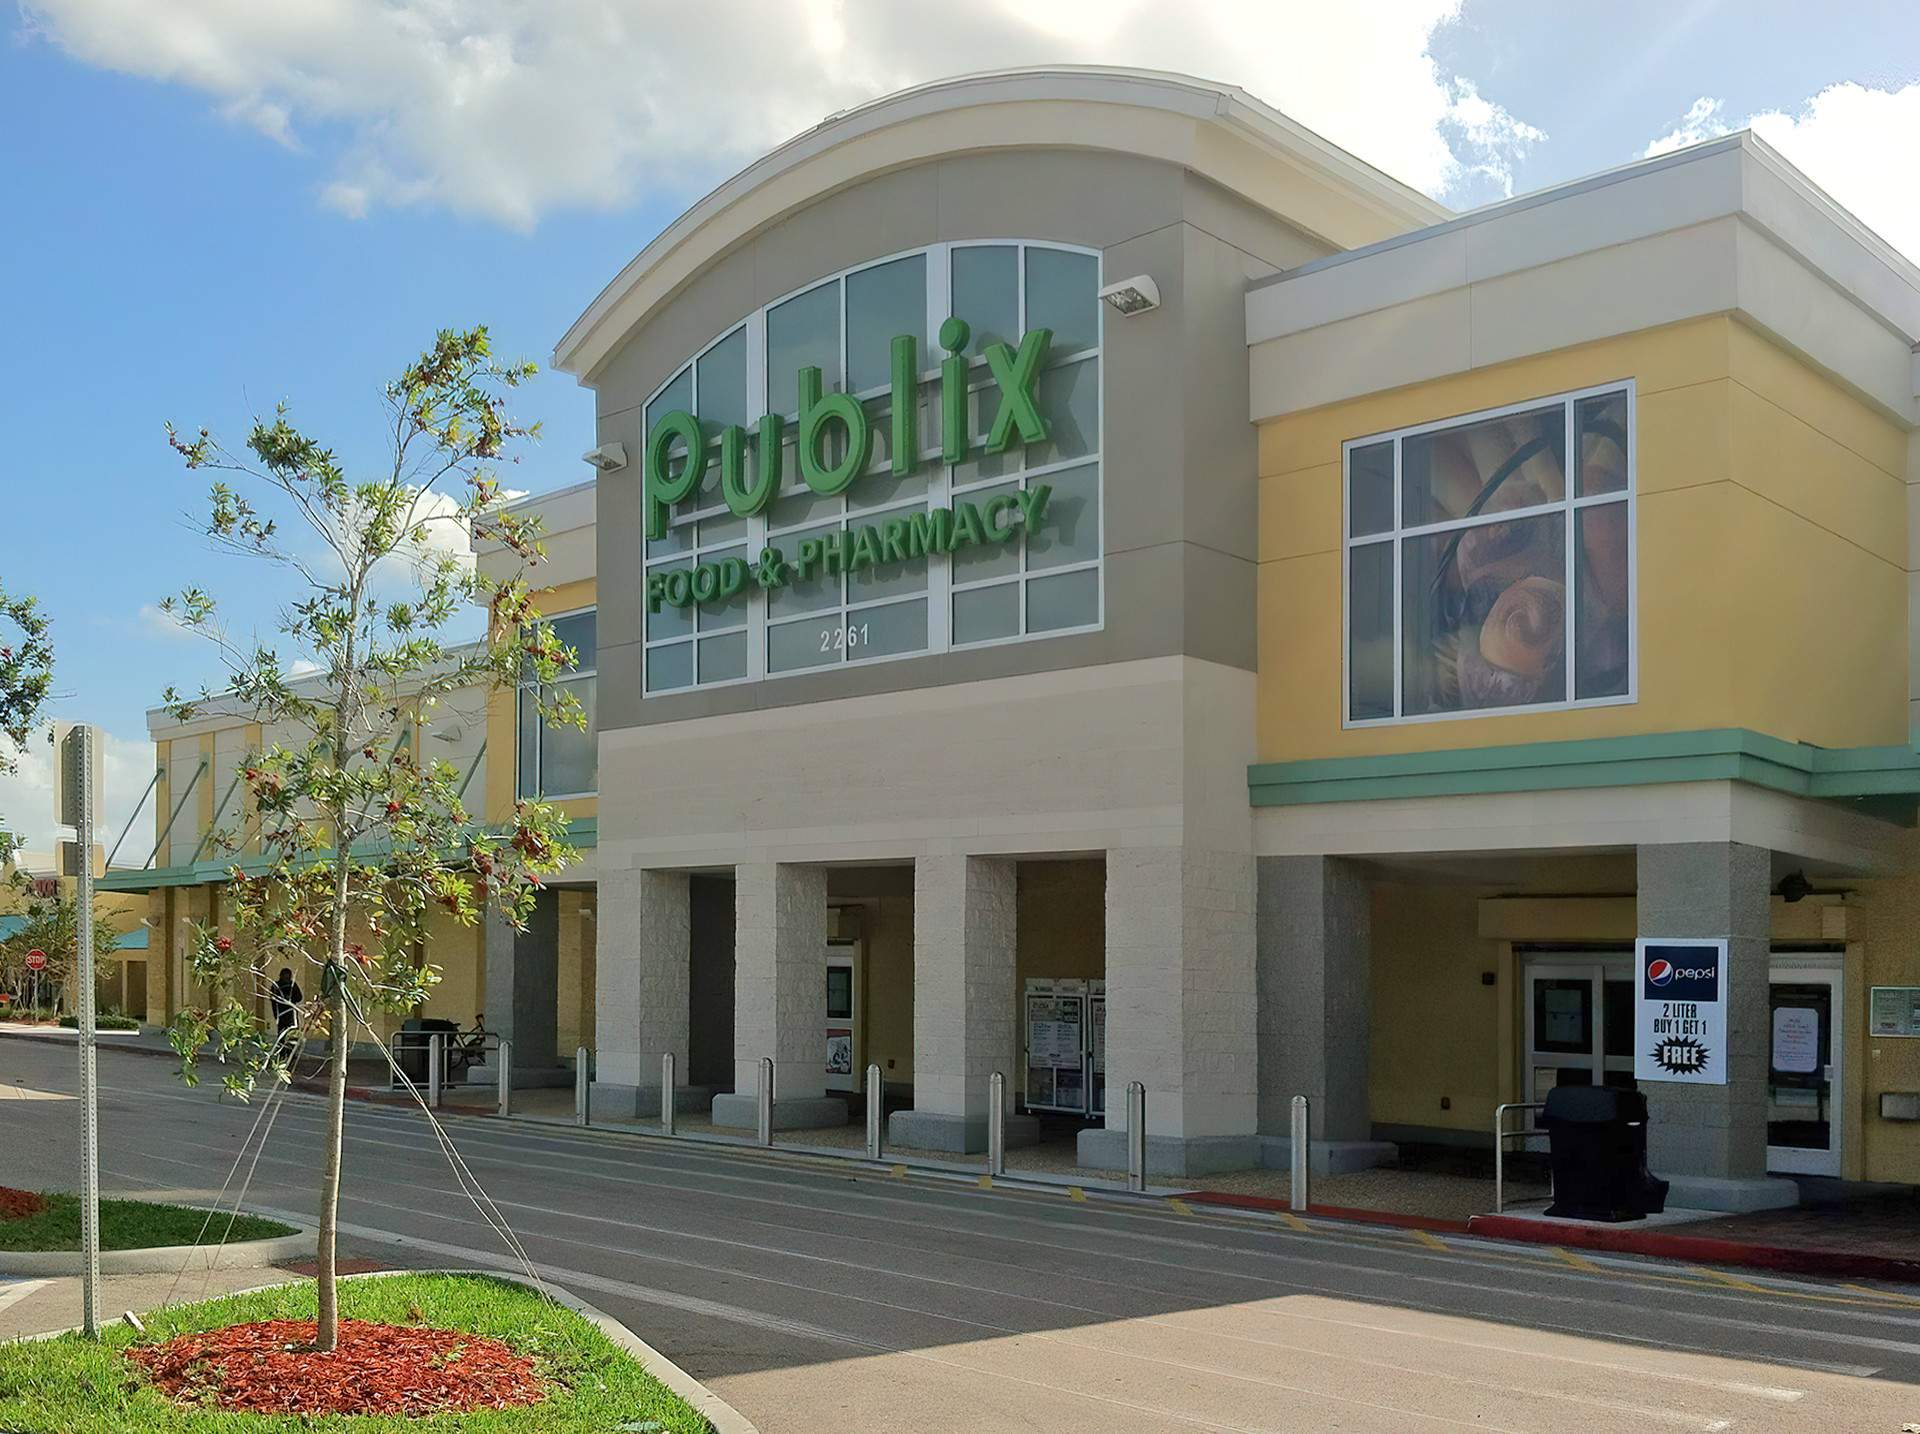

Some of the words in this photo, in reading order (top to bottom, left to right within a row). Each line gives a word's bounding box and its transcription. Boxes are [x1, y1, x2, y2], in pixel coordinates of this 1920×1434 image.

[647, 557, 749, 613] FOOD
[757, 547, 787, 588] &
[799, 485, 1052, 577] PHARMACY
[820, 623, 870, 652] 2261
[27, 956, 45, 964] STOP
[1675, 967, 1715, 980] pepsi
[1663, 1003, 1669, 1018] 2
[1673, 1003, 1697, 1018] LITER
[1654, 1019, 1673, 1034] BUY
[1675, 1020, 1679, 1034] 1
[1683, 1020, 1699, 1035] GET
[1702, 1020, 1706, 1035] 1
[1663, 1046, 1700, 1065] FREE
